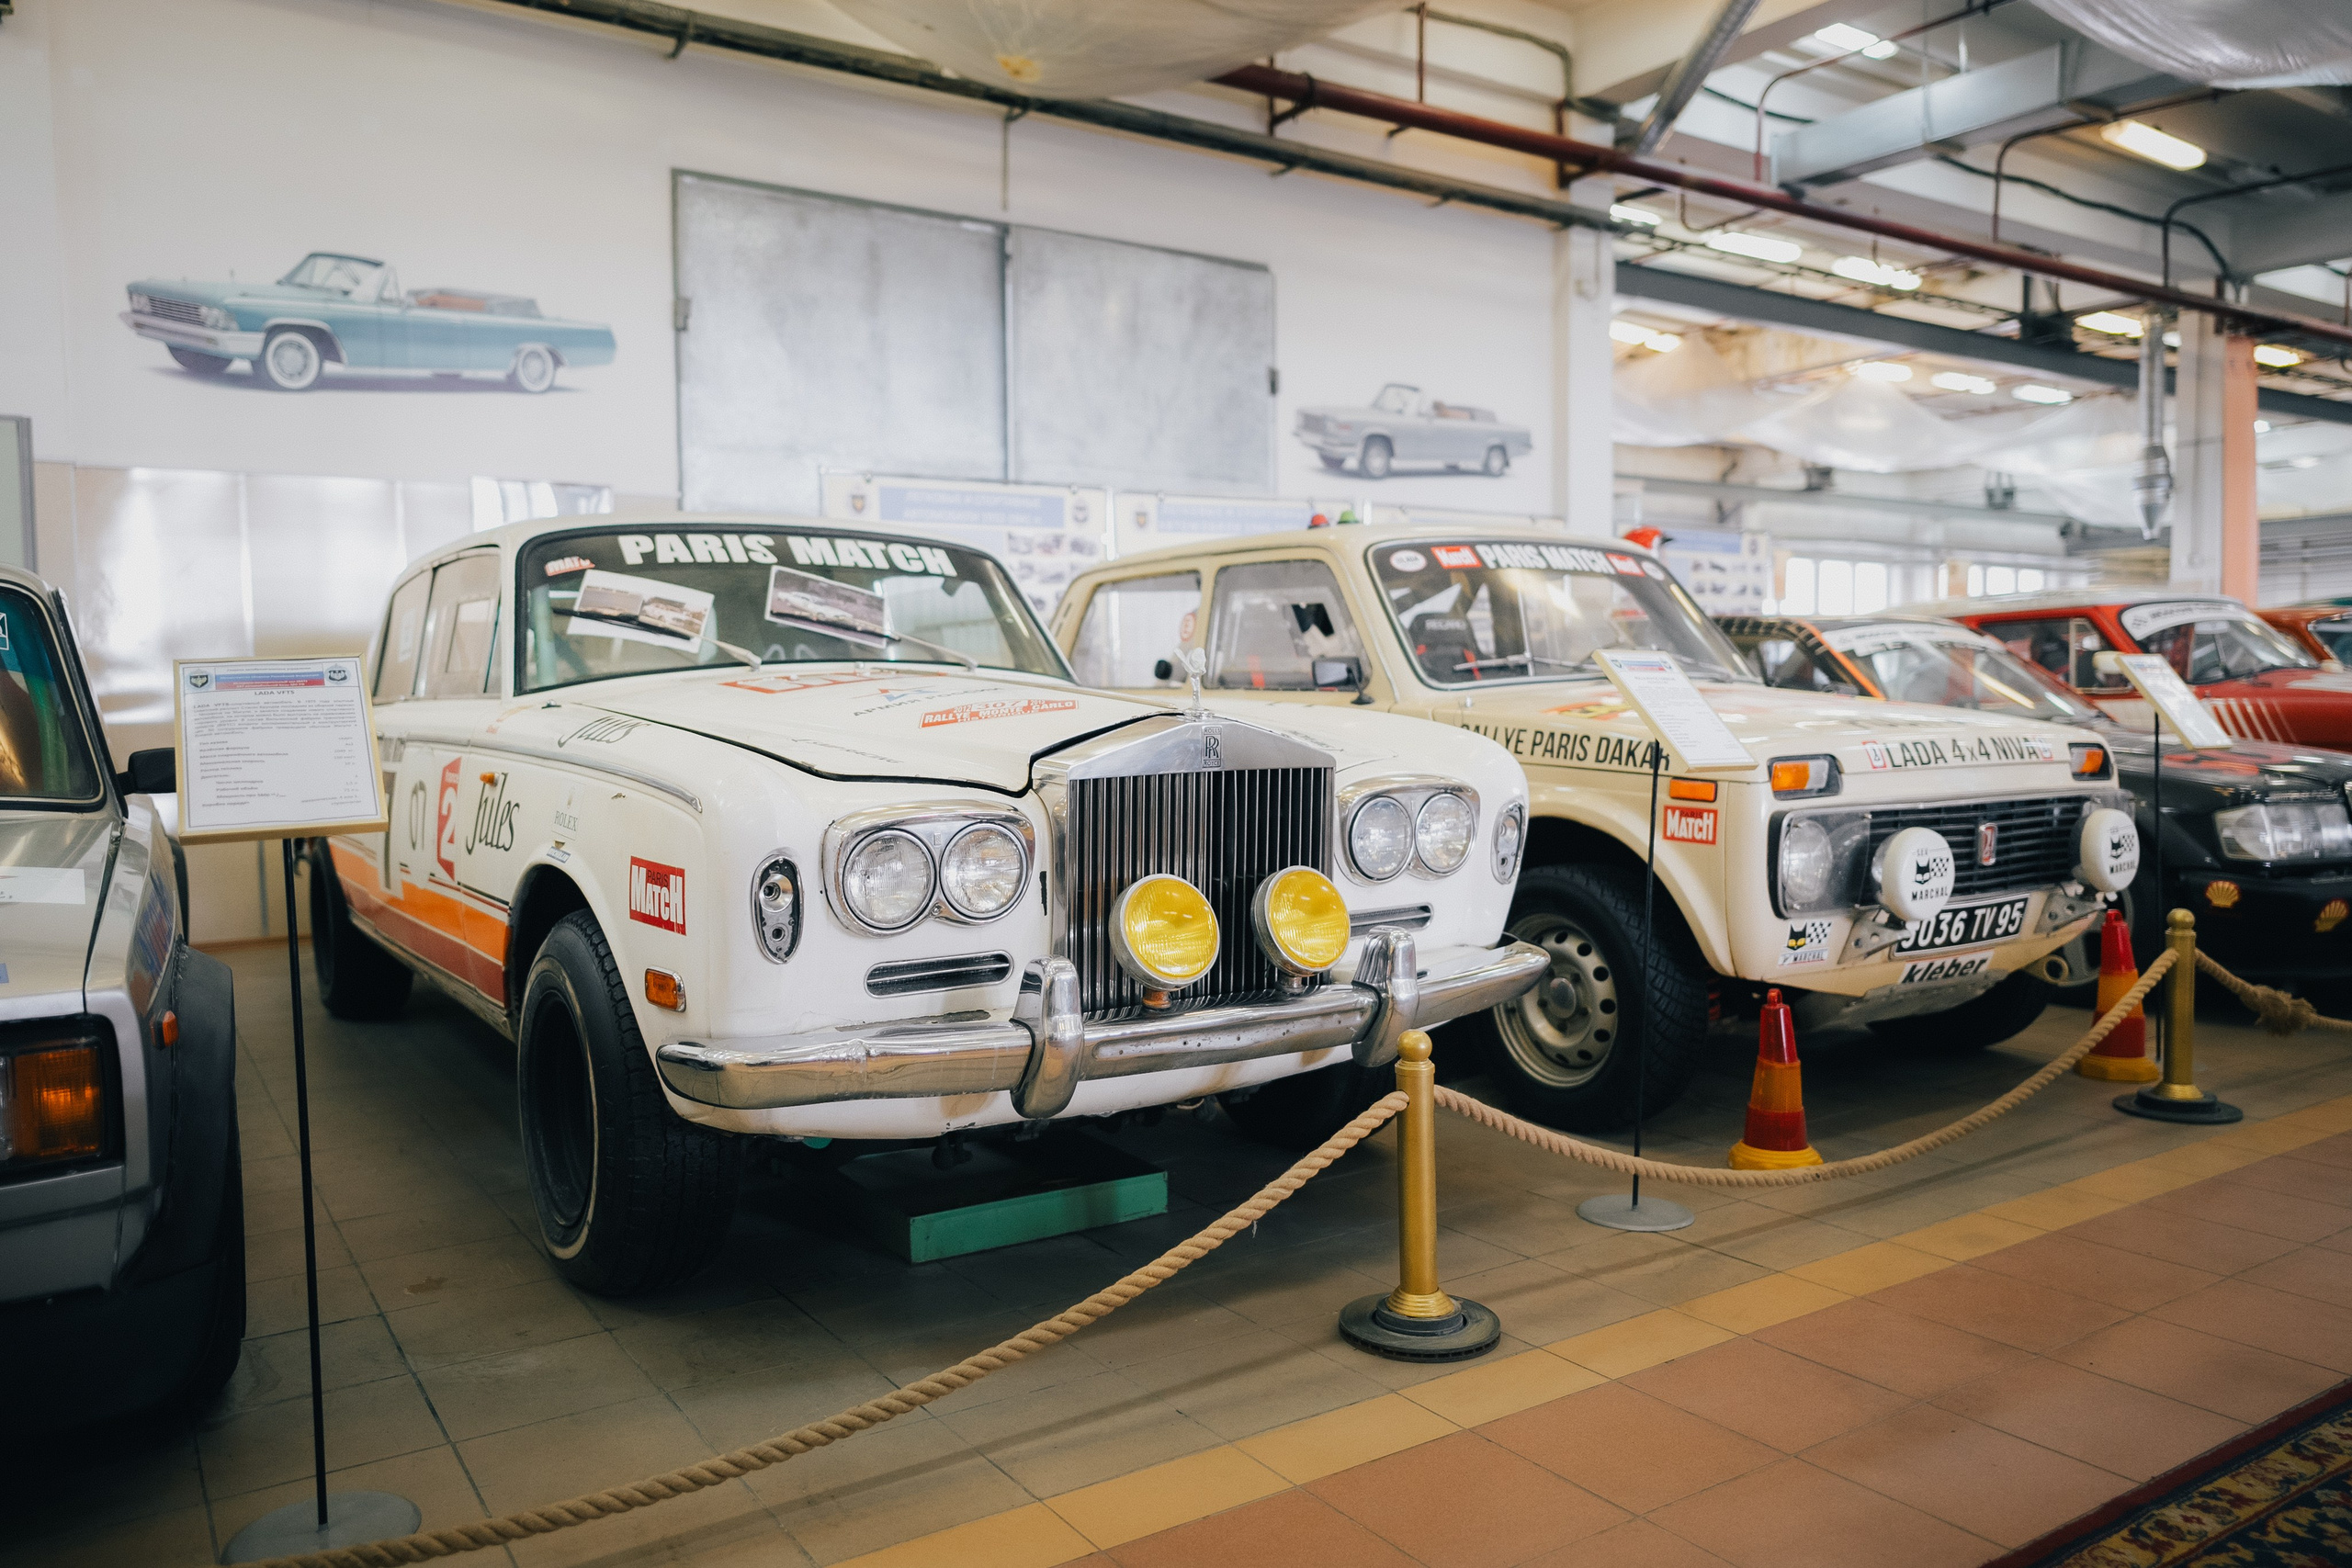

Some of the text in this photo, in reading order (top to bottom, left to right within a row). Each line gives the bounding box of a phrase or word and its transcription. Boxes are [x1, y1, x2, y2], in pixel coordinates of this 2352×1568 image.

[617, 534, 957, 577] PARIS MATCH
[1476, 545, 1616, 575] PARIS MATCH
[924, 701, 1073, 723] RALLYE MONTE CARLO
[977, 700, 1023, 710] 307
[1531, 730, 1590, 762] PARIS
[1886, 739, 1949, 769] LADA
[1991, 737, 2040, 761] NIVA
[465, 772, 521, 855] Jules
[554, 810, 578, 832] ROLEX
[1667, 808, 1713, 841] MATCH
[647, 869, 669, 887] PARIS
[1911, 886, 1949, 901] MARCHAL
[631, 864, 684, 925] MATCH
[1971, 906, 1998, 941] TV
[1995, 901, 2025, 936] 95
